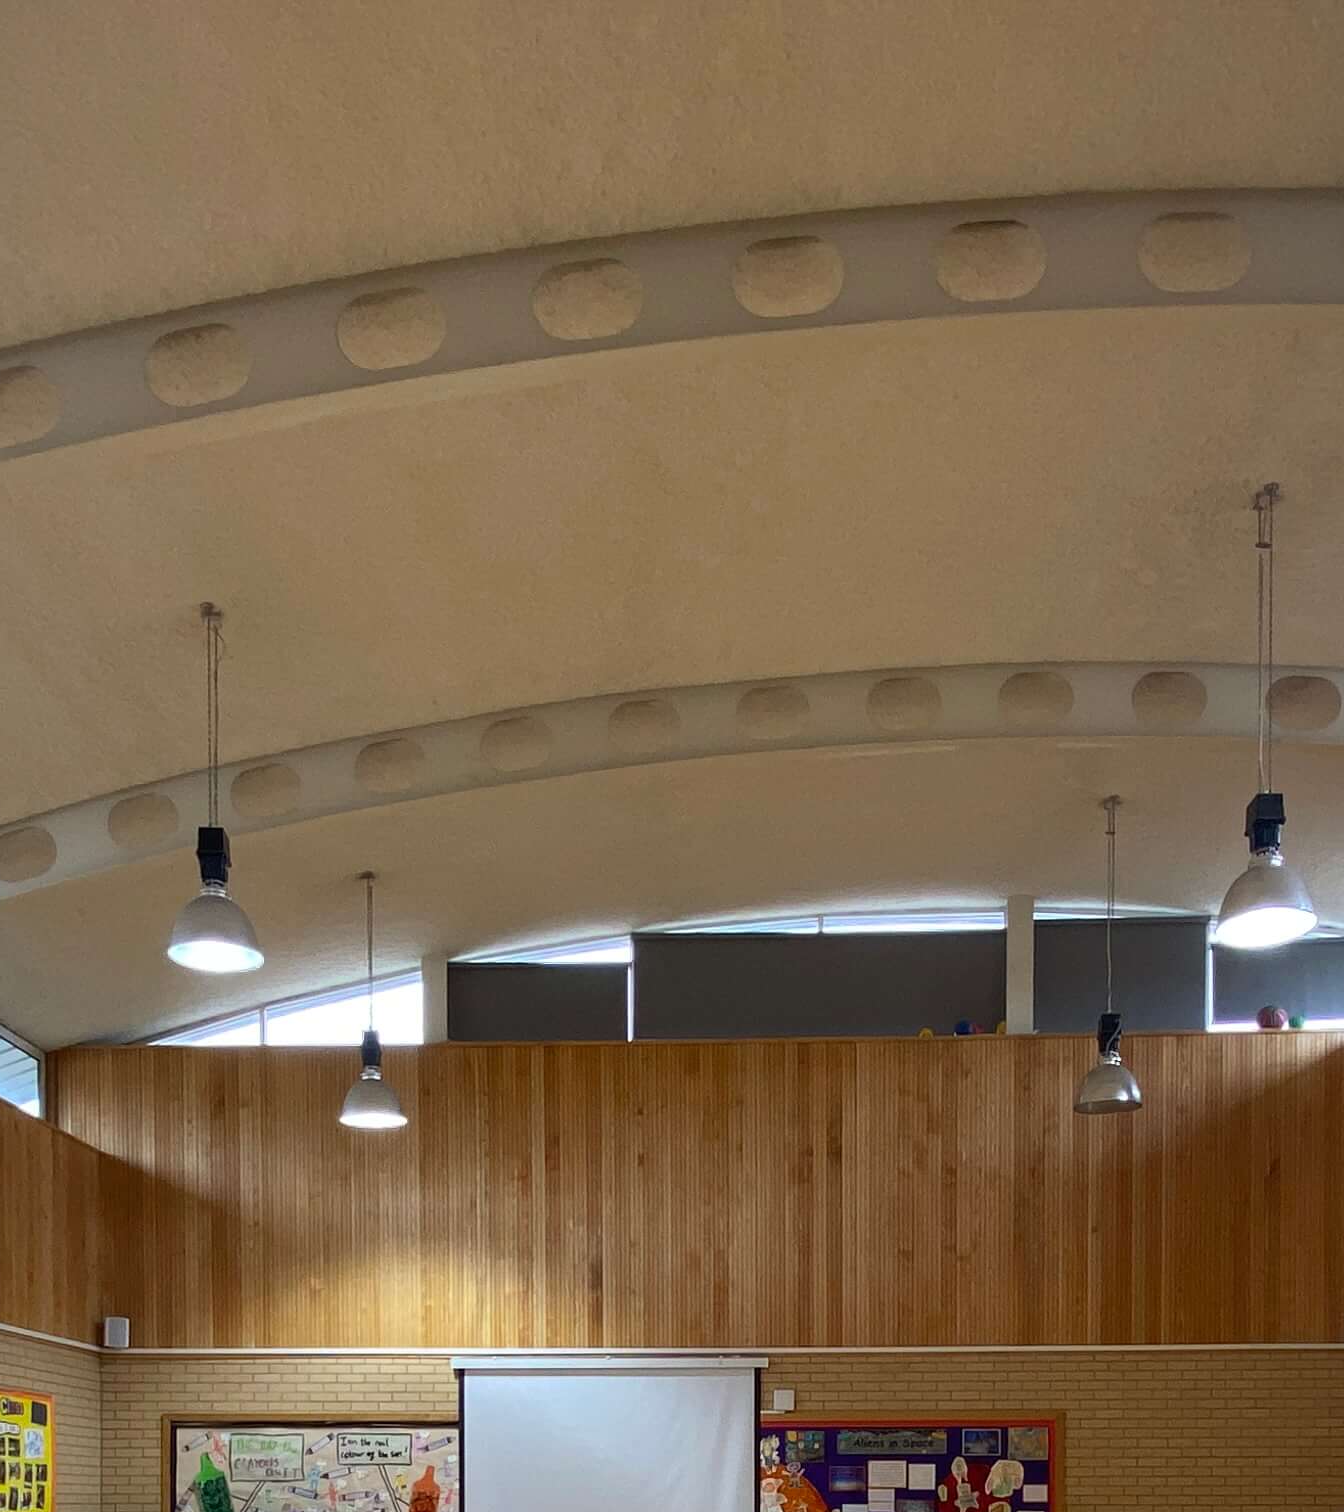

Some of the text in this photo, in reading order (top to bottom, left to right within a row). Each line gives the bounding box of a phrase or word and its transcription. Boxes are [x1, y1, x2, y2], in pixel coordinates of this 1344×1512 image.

[360, 1437, 371, 1447] the
[853, 1438, 885, 1449] Aliens
[888, 1439, 899, 1448] in
[378, 1449, 389, 1458] the
